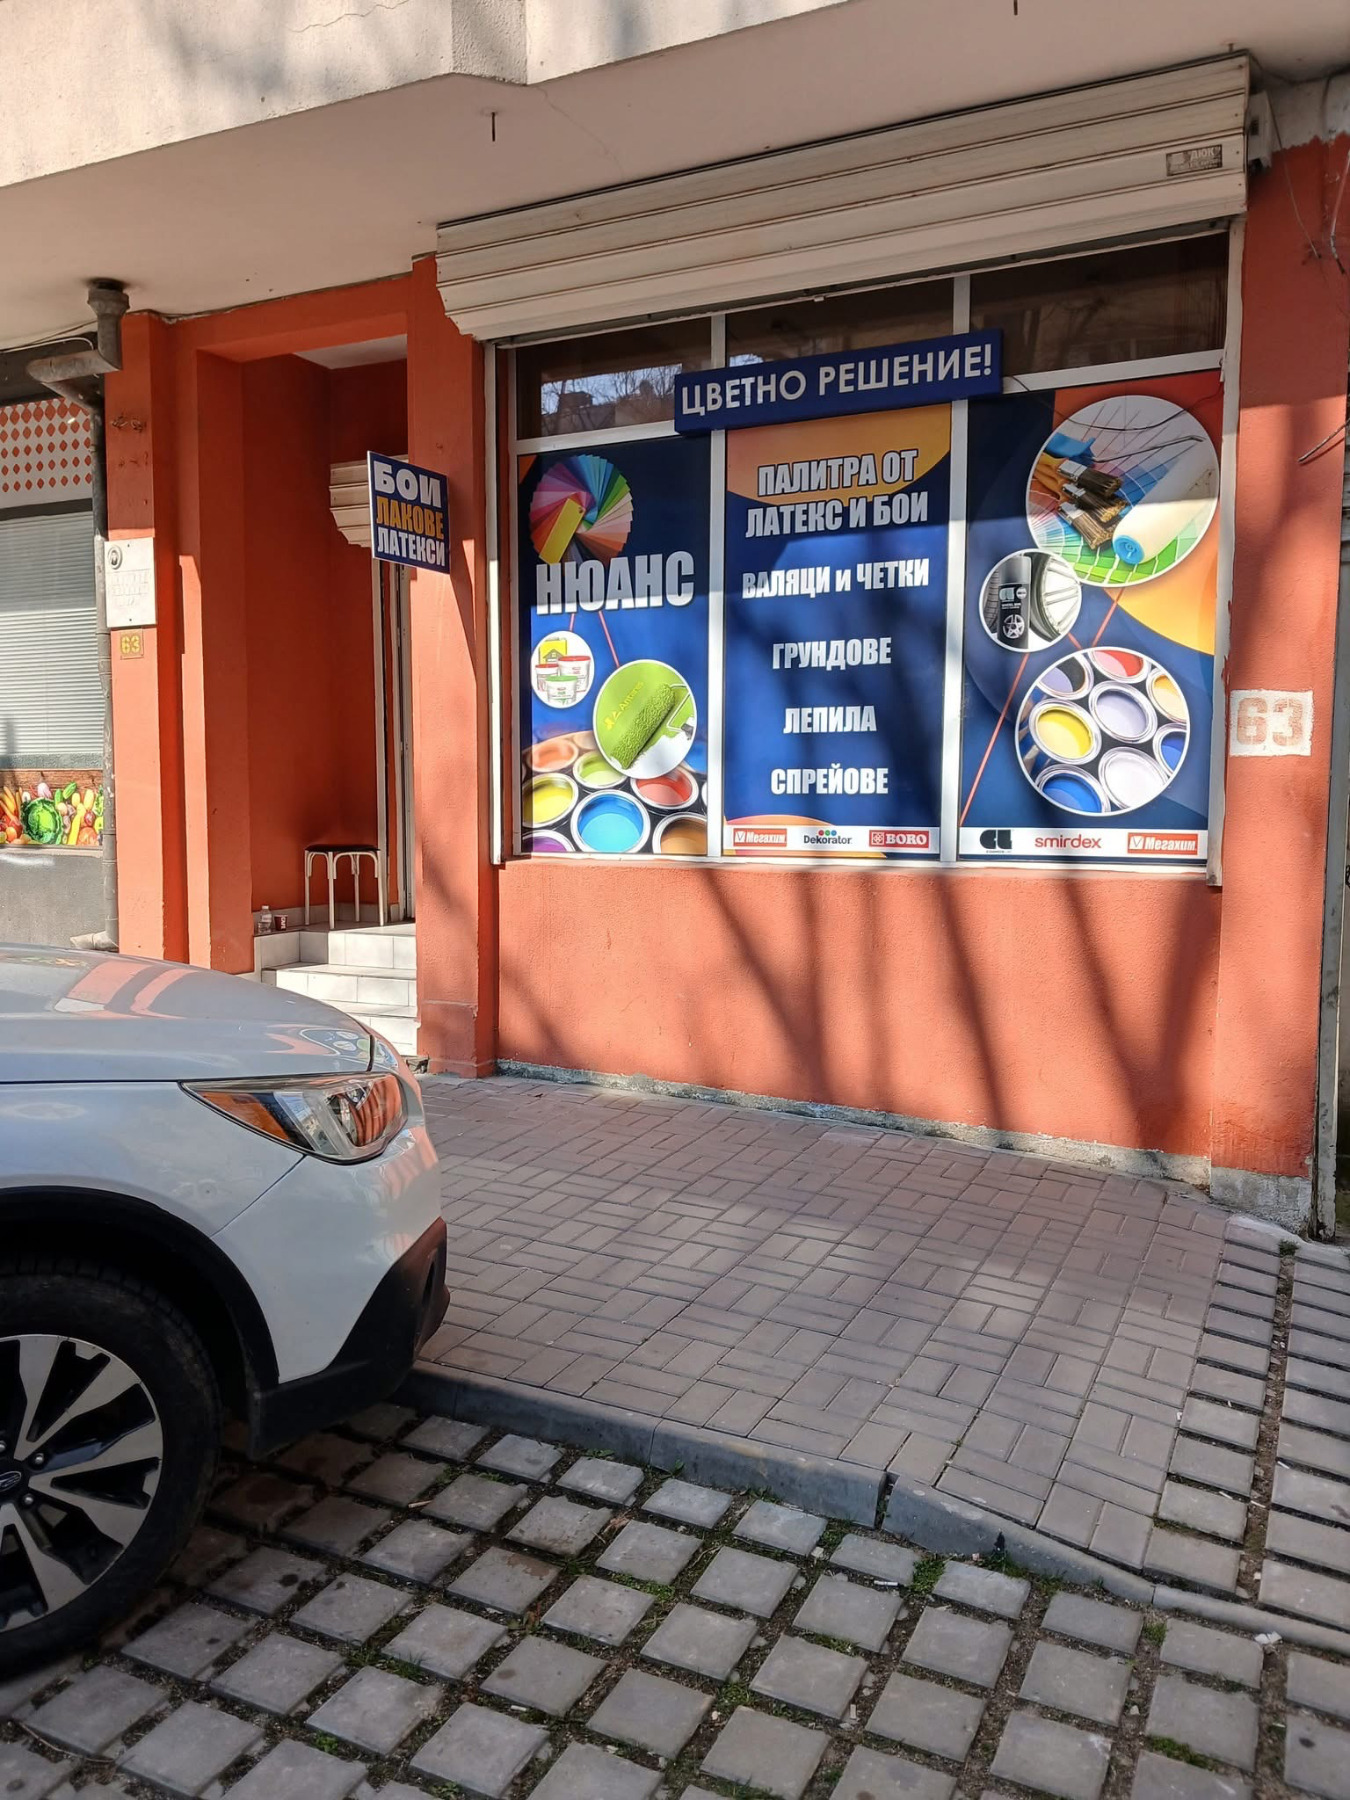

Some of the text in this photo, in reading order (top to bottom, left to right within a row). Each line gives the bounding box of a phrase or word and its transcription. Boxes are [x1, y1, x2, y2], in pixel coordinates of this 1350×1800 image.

[682, 343, 991, 416] ЦВЕТНО РЕШЕНИЕ!
[374, 461, 441, 508] БОИ
[758, 449, 917, 496] ПАЛИТРА ОТ
[377, 496, 444, 539] ЛАКОВЕ
[745, 491, 928, 538] ЛАТЕКС И БОИ
[377, 527, 445, 567] ЛАТЕКСИ
[536, 551, 694, 615] НЮАНС
[742, 558, 929, 599] ВАЛЯЦИ и ЧЕТКИ
[121, 635, 141, 655] 63
[772, 637, 892, 671] ГРУНДОВЕ
[783, 705, 877, 734] ЛЕПИЛА
[1237, 697, 1303, 746] 63
[771, 763, 888, 794] СПРЕЙОВЕ
[803, 835, 852, 845] Dekorator
[886, 833, 927, 845] BORO
[1034, 833, 1102, 849] smirdex
[1144, 836, 1196, 851] Мегахим
